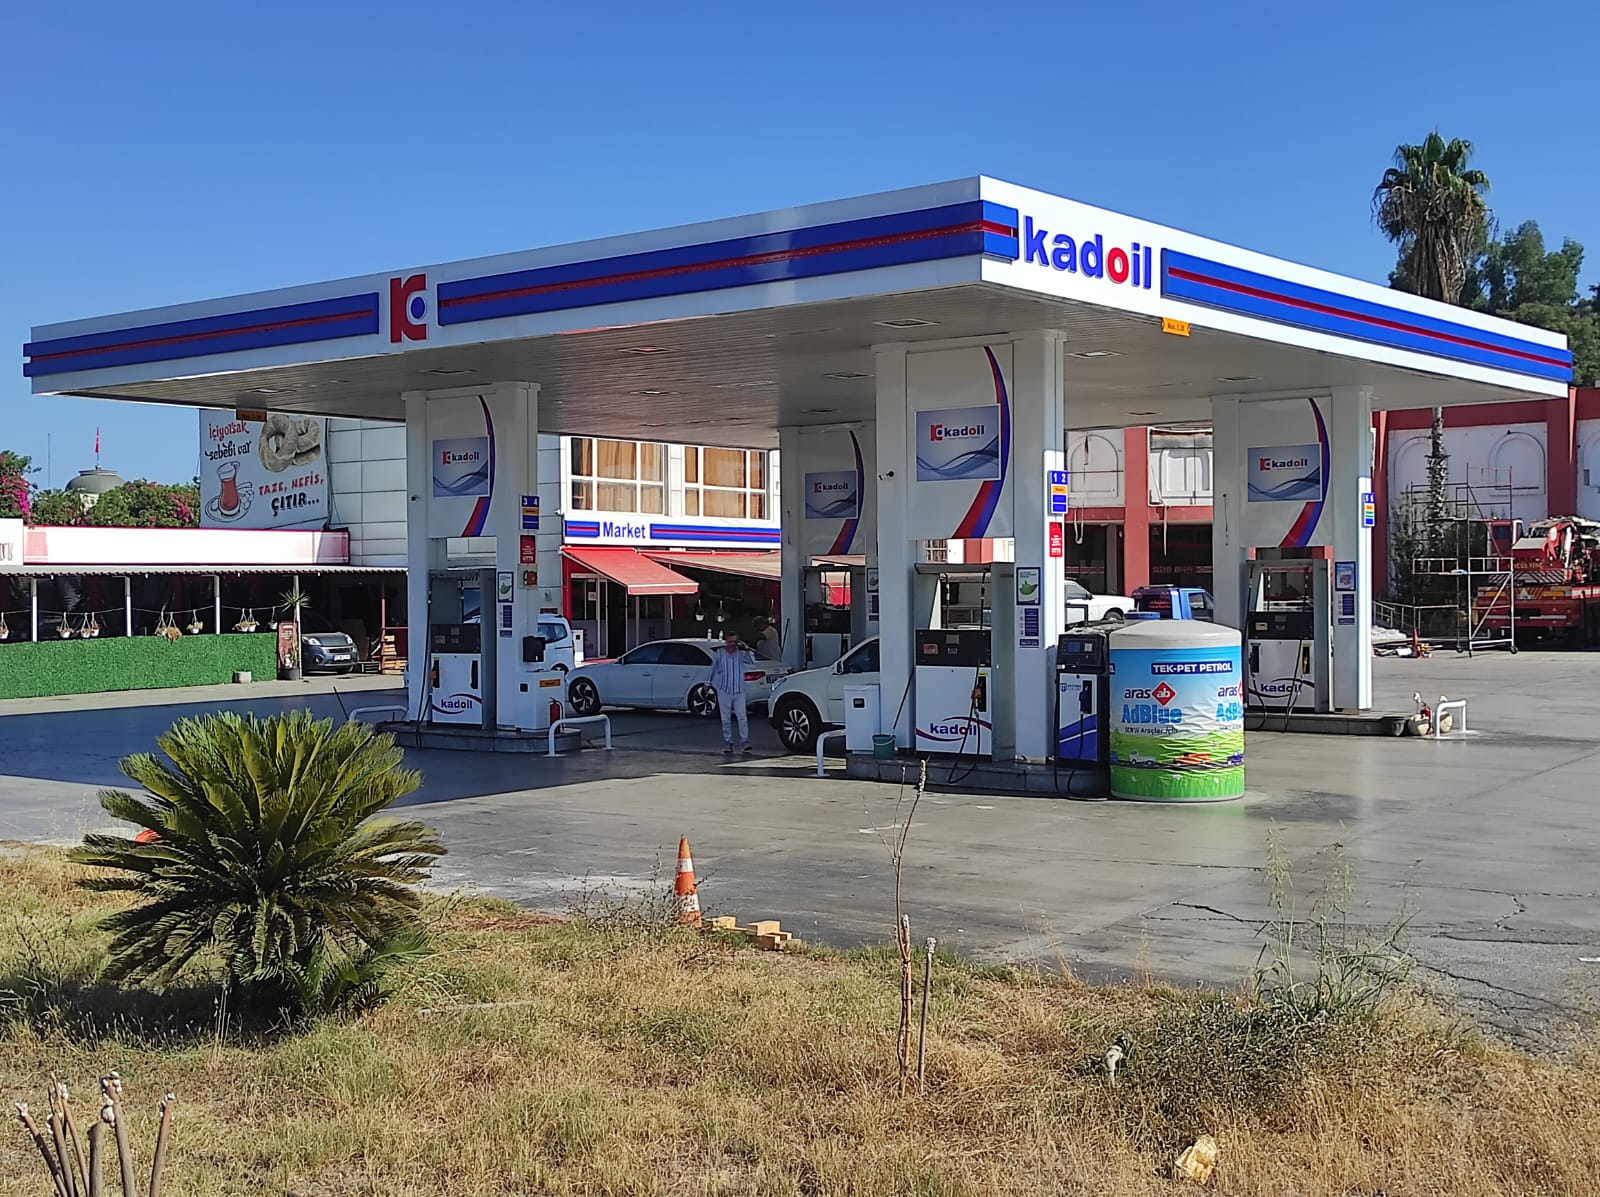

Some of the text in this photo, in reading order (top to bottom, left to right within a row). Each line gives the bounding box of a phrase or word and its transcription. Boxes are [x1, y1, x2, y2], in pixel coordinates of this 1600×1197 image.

[1024, 215, 1152, 289] kadoil
[944, 425, 985, 437] kadoil
[452, 451, 480, 461] kadoil
[1272, 459, 1308, 468] kadoil
[1054, 473, 1067, 483] 1 2
[523, 497, 538, 506] 3 4
[602, 521, 646, 540] Market
[1153, 662, 1232, 673] TEK-PET PETROL
[1124, 688, 1151, 699] aras
[1217, 686, 1238, 698] aras
[441, 699, 473, 710] kadoil
[1121, 704, 1182, 724] AdBlue
[930, 723, 977, 736] kadoil
